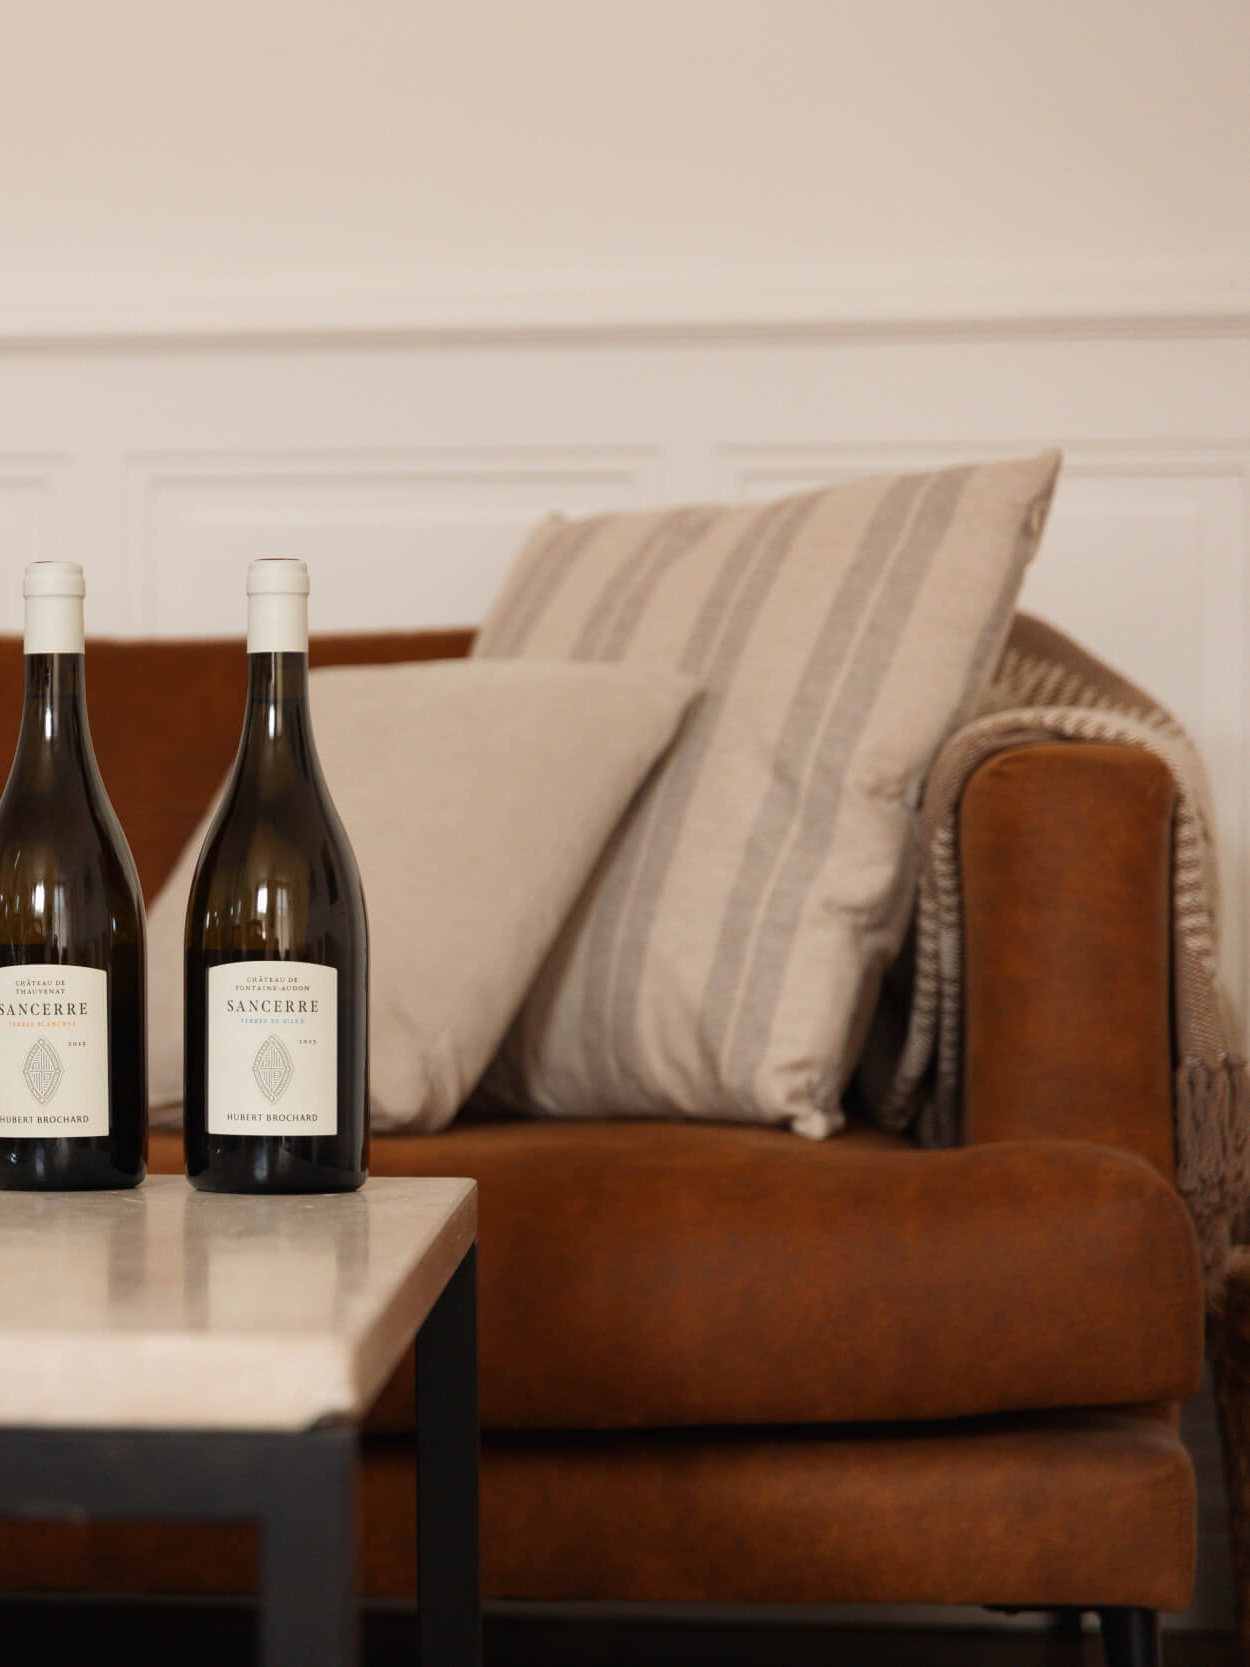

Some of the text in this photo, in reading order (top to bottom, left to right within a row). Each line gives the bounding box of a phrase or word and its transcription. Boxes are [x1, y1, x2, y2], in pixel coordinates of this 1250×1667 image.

[15, 979, 53, 987] CHÂTEAU
[226, 999, 319, 1013] SANCERRE
[0, 1115, 89, 1124] HUBERT BROCHARD
[226, 1113, 318, 1122] HUBERT BROCHARD
